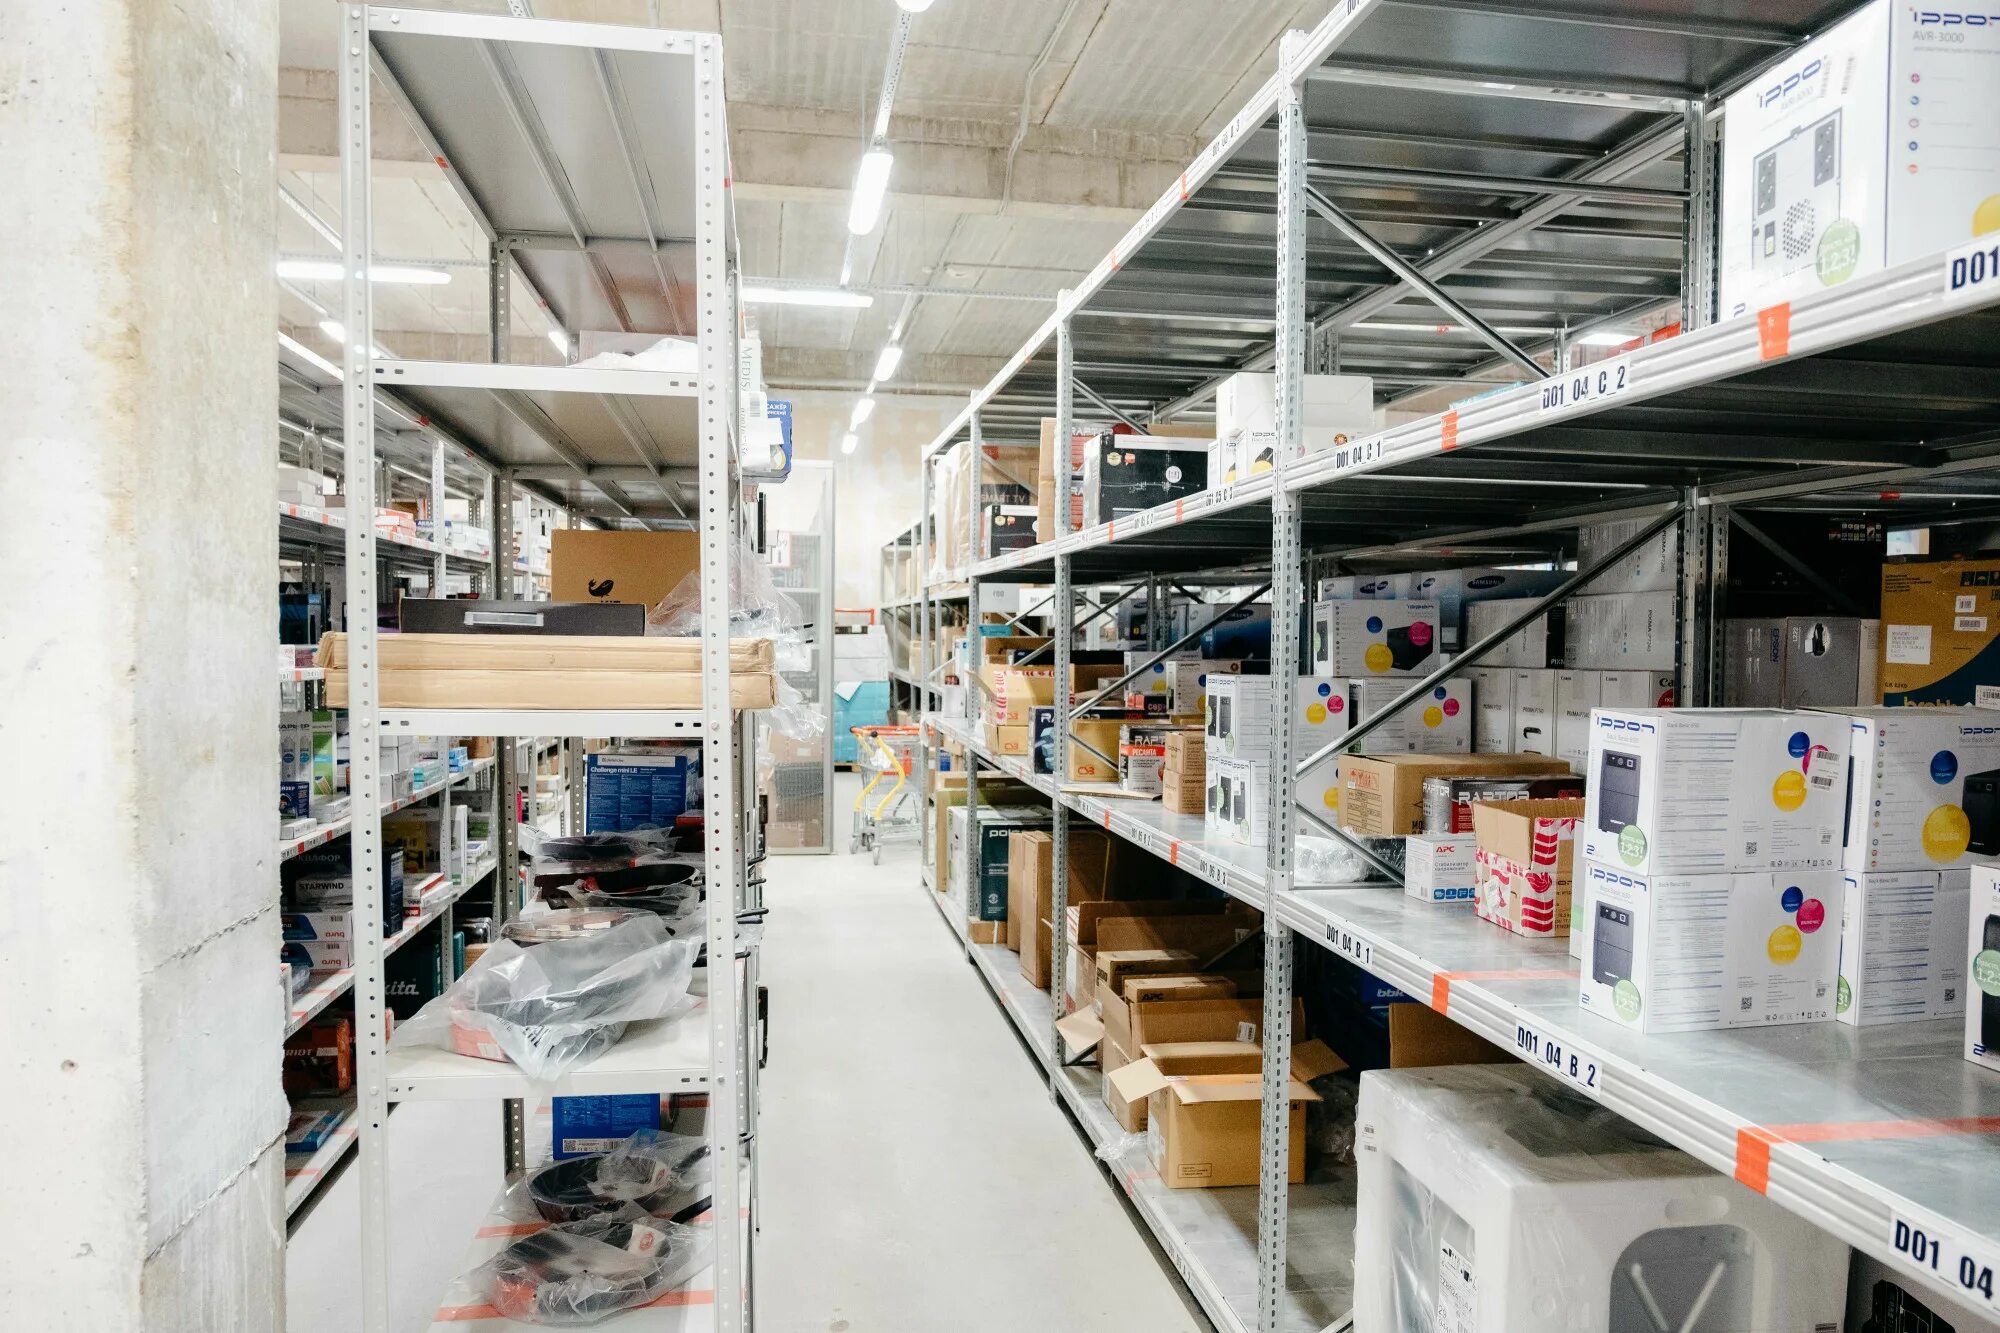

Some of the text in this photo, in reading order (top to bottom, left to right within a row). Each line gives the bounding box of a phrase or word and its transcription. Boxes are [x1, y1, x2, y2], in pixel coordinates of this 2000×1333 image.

[1013, 494, 1025, 503] TV
[1594, 713, 1655, 735] ippon
[1135, 736, 1165, 746] RAPT
[590, 766, 617, 774] Challenge
[1423, 783, 1450, 798] RAPTOR
[1588, 864, 1647, 892] ippon
[298, 882, 344, 891] STARWIND
[385, 981, 420, 996] ita
